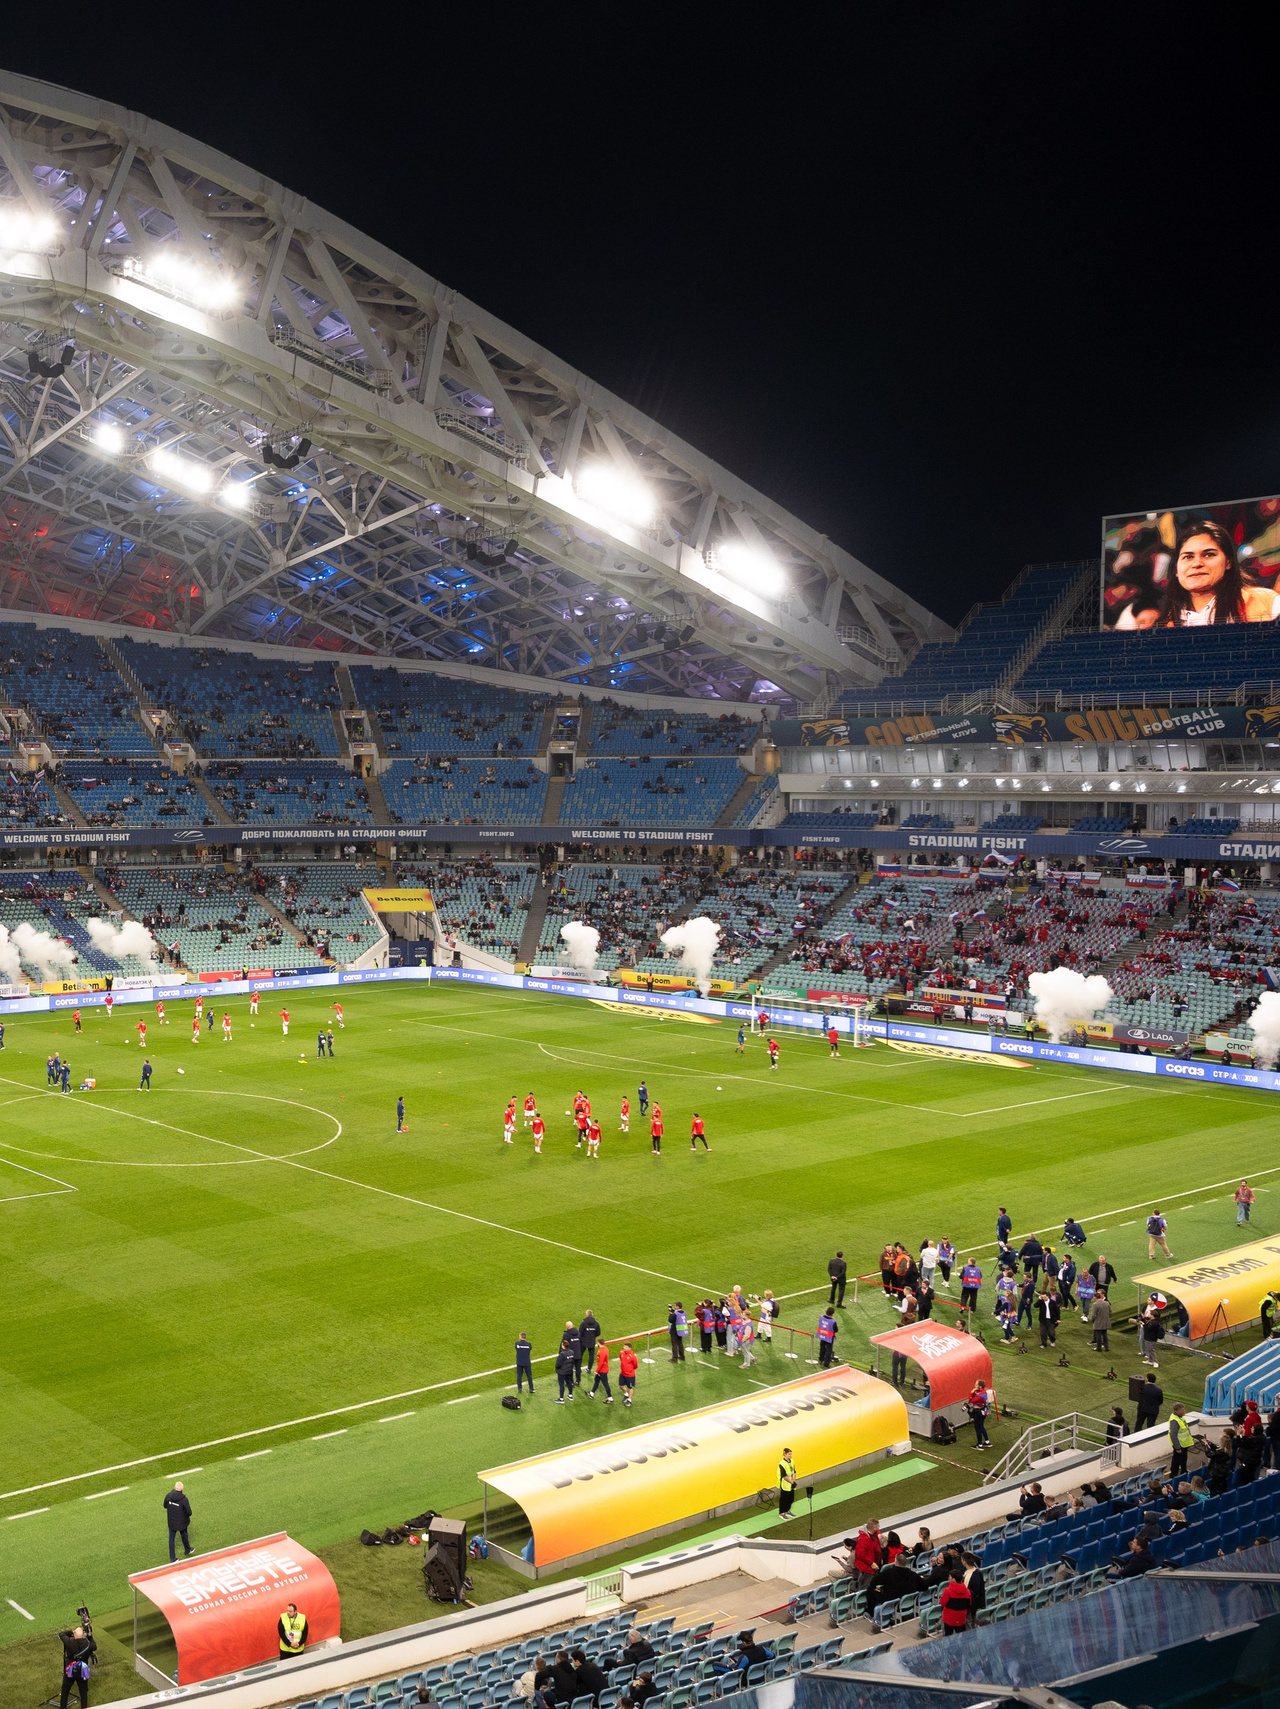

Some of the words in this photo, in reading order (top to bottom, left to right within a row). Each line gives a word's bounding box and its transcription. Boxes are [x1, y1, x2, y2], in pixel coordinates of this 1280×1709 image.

[865, 716, 939, 745] СОЧИ
[905, 719, 971, 742] ФУТБОЛЬНЫЙ
[952, 727, 977, 739] КЛУБ
[1143, 708, 1219, 735] FOOTBALL
[1187, 719, 1225, 736] CLUB
[4, 834, 48, 844] WELCOME
[51, 834, 62, 843] TO
[65, 833, 104, 843] STADIUM
[106, 832, 131, 842] FISHT
[241, 830, 270, 840] ДОБРО
[273, 829, 335, 839] ПОЖАЛОВАТЬ
[338, 829, 350, 838] НА
[353, 829, 395, 838] СТАДИОН
[398, 828, 427, 838] ФИШТ
[571, 829, 621, 840] WELCOME
[624, 830, 637, 840] TO
[639, 830, 683, 841] STADIUM
[685, 831, 714, 842] FISHT
[909, 835, 977, 847] STADIUM
[982, 837, 1026, 849] FISHT
[1151, 1033, 1174, 1043] LADA
[1167, 1257, 1268, 1288] BetBoom
[535, 1433, 699, 1489] BetBoom
[711, 1382, 859, 1434] BetBoom
[169, 1550, 277, 1588] СИЛЬНЫЕ
[173, 1556, 304, 1607] ВМЕСТЕ
[188, 1597, 226, 1615] СБОРНАЯ
[228, 1588, 259, 1604] РОССИИ
[260, 1584, 272, 1594] ПО
[273, 1572, 309, 1591] ФУТБОЛУ
